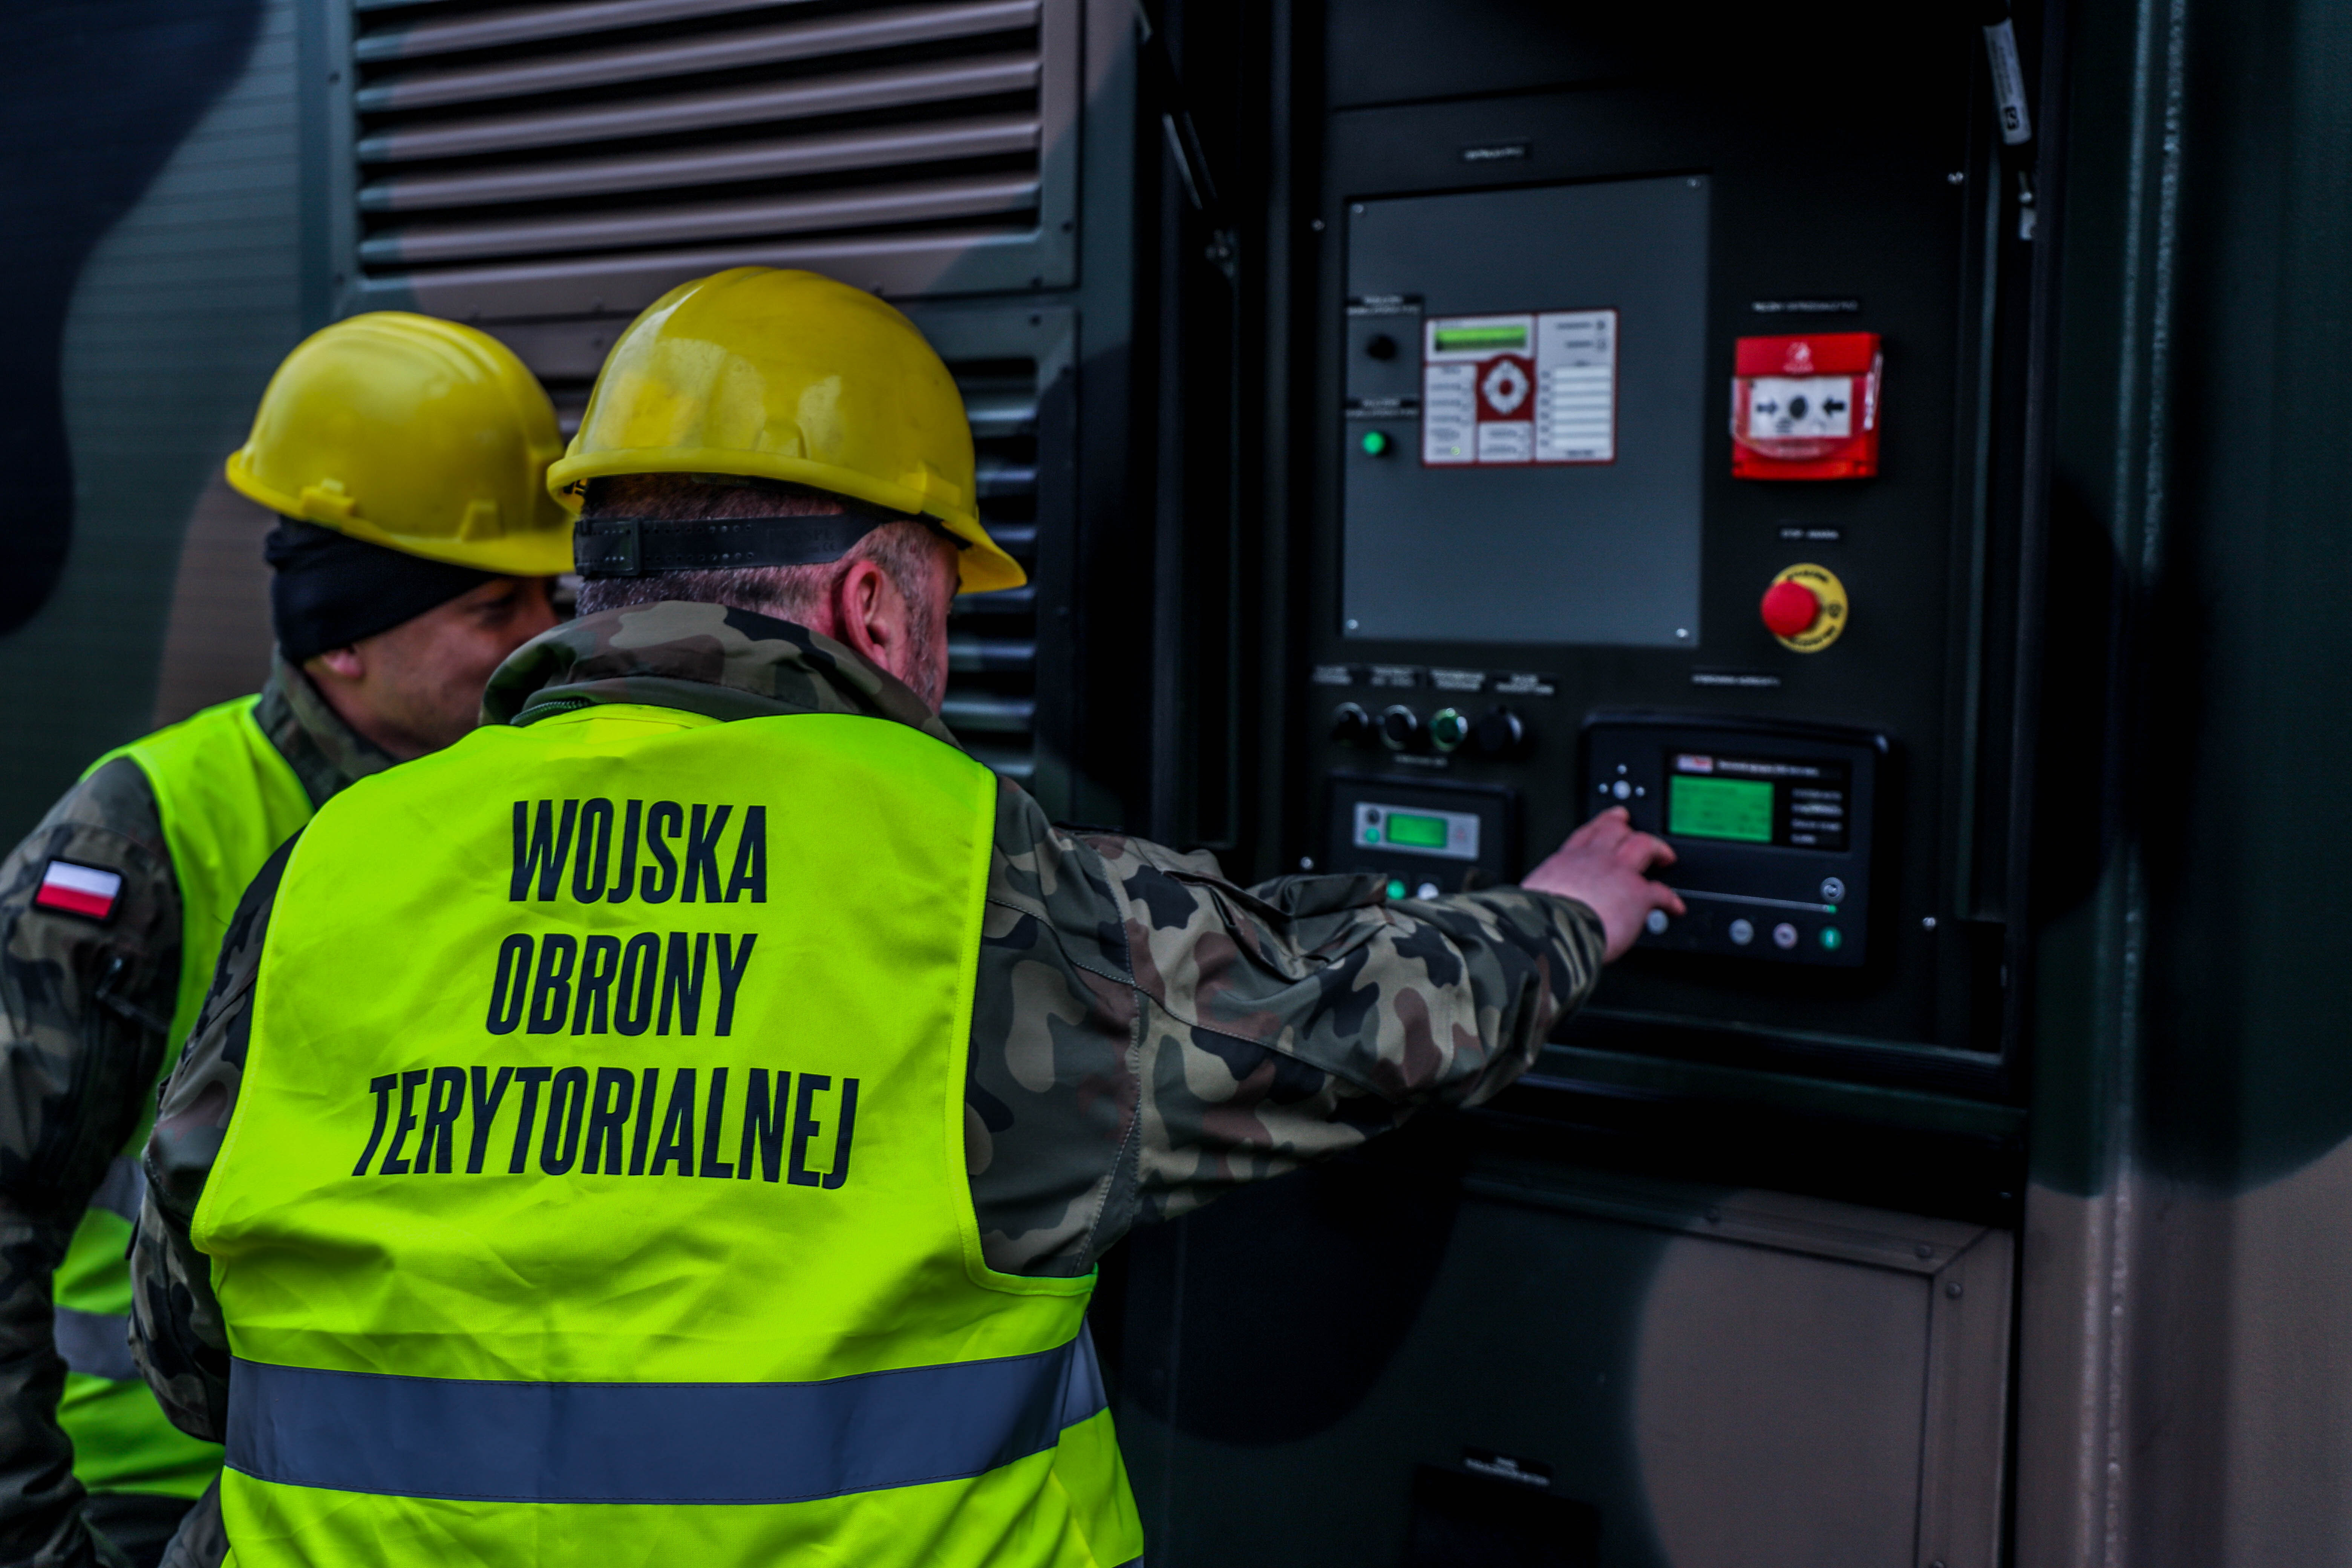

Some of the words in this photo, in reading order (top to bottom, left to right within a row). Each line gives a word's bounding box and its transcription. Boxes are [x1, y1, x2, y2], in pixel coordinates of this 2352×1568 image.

[510, 798, 766, 903] WOJSKA
[487, 932, 757, 1036] OBRONY
[353, 1066, 859, 1189] TERYTORIALNEJ
